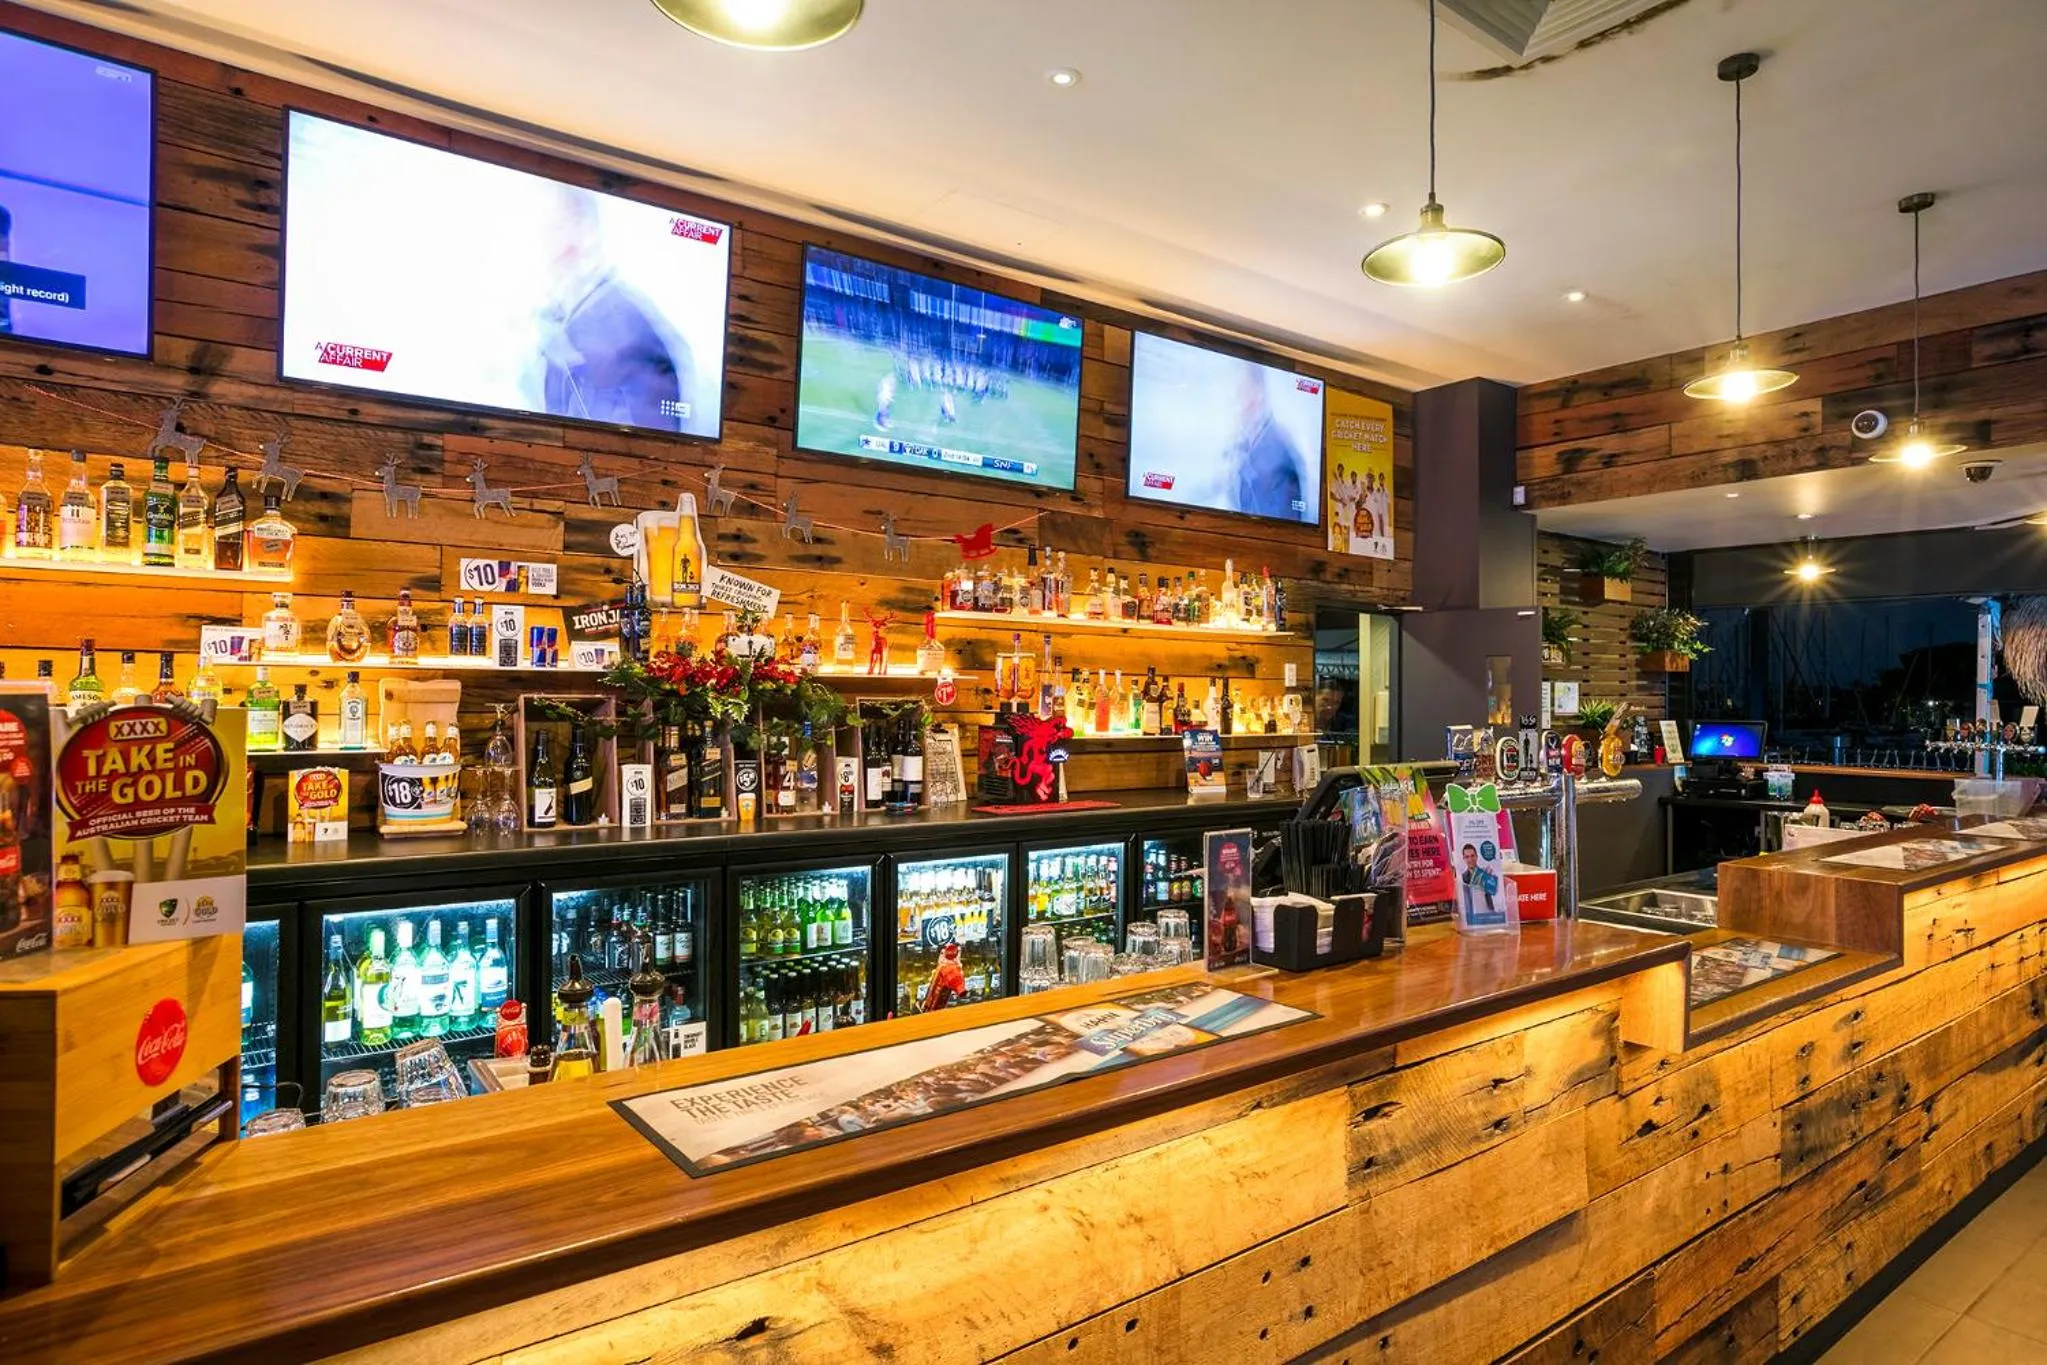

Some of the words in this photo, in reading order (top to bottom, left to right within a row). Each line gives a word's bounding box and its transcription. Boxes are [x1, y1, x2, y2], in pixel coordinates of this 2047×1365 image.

[27, 288, 69, 304] record)
[320, 352, 364, 368] AFFAIR
[327, 343, 390, 362] CURRENT
[1335, 418, 1360, 430] CATCH
[467, 563, 496, 586] $10
[719, 574, 755, 593] KNOWN
[756, 586, 773, 599] FOR
[499, 618, 517, 632] $10
[572, 610, 608, 630] IRON
[207, 639, 229, 655] $10
[114, 720, 165, 738] XXXX
[82, 742, 175, 777] TAKE
[179, 754, 197, 768] IN
[75, 780, 108, 795] THE
[111, 769, 208, 804] GOLD
[303, 780, 328, 792] TAKE
[309, 788, 338, 800] GOLD
[388, 781, 413, 804] $18
[629, 777, 646, 792] $10
[75, 818, 139, 838] AUSTRALIAN
[139, 814, 182, 827] CRICKET
[182, 814, 210, 823] TEAM
[88, 812, 134, 827] OFFICIAL
[135, 808, 162, 819] BEER
[162, 807, 178, 817] OF
[178, 806, 197, 816] THE
[1407, 835, 1419, 845] TO
[1419, 834, 1440, 845] EARN
[1421, 846, 1441, 857] HERE
[1531, 892, 1548, 902] HERE
[930, 921, 949, 941] $18
[138, 1020, 186, 1065] Coca-Cola
[669, 1075, 809, 1110] EXPERIENCE
[680, 1103, 730, 1119] THE
[731, 1089, 802, 1110] TASTE
